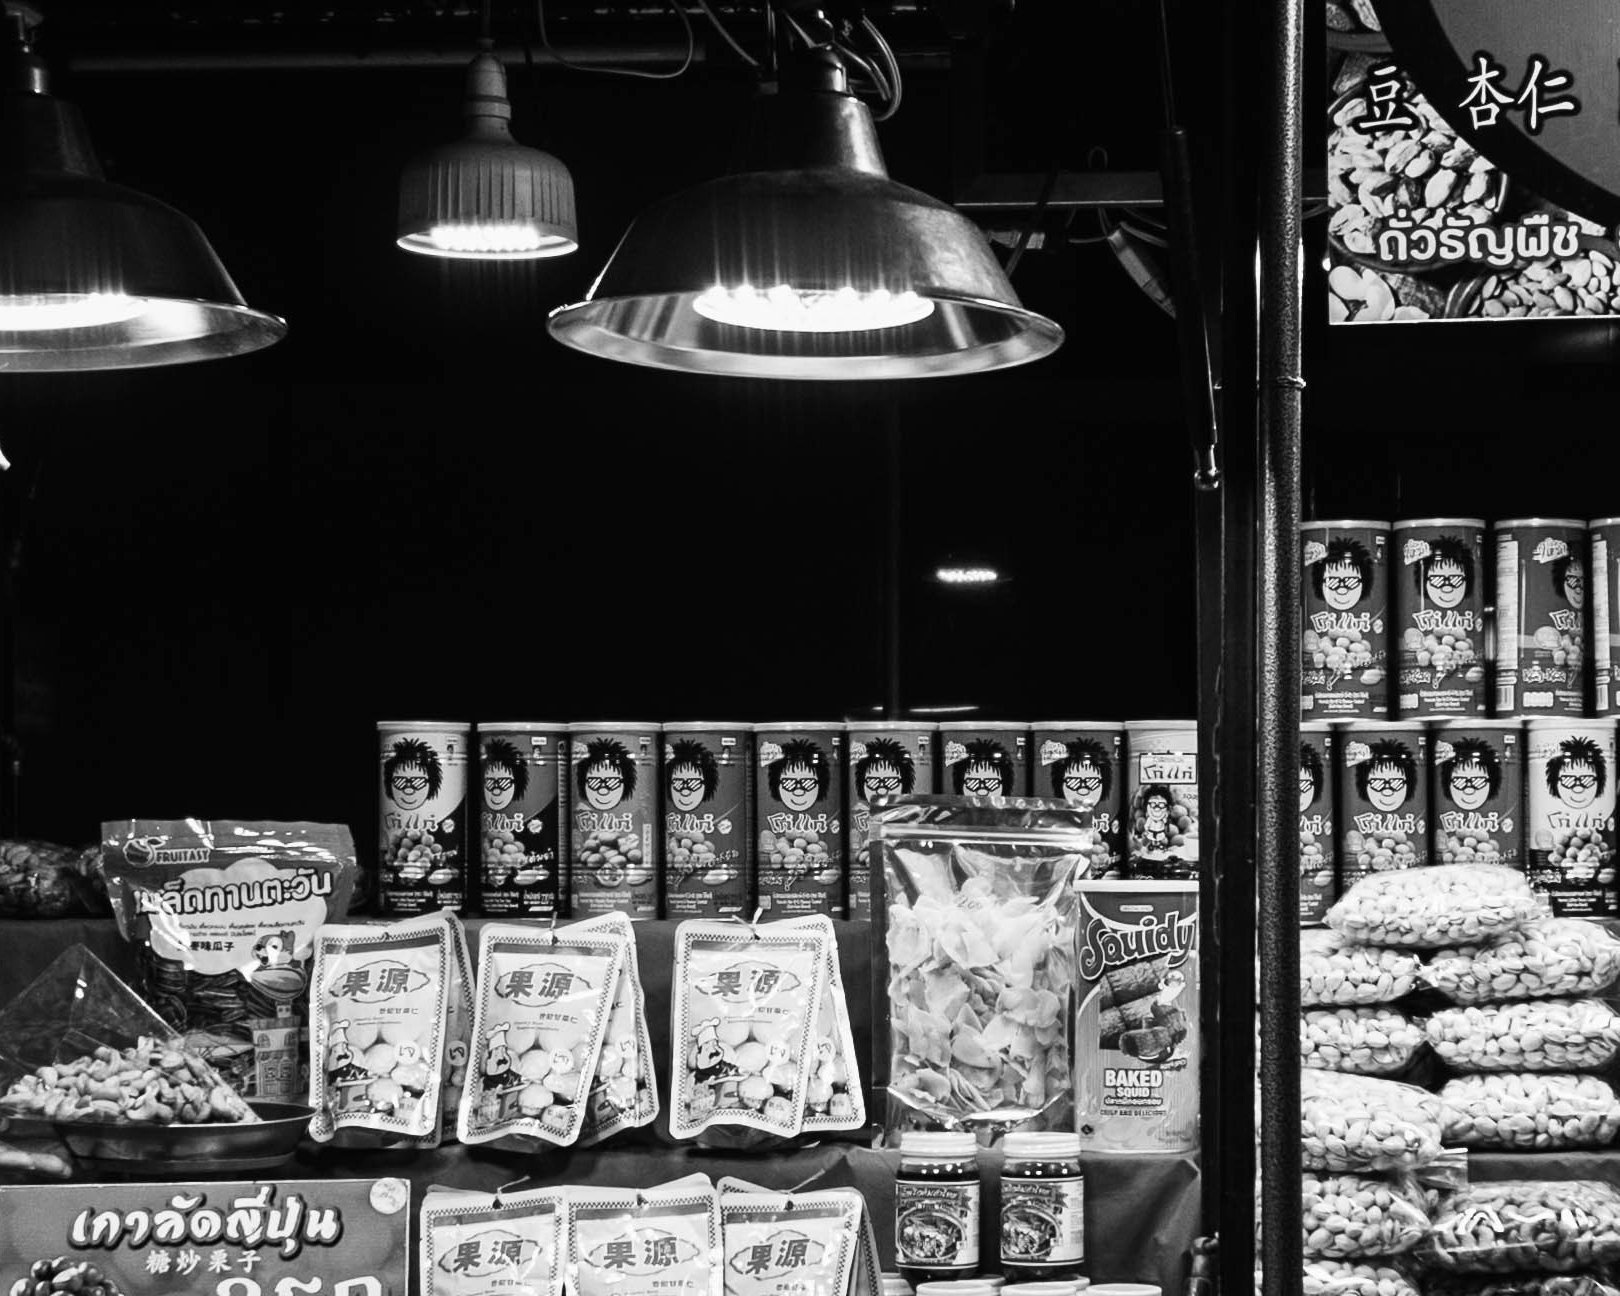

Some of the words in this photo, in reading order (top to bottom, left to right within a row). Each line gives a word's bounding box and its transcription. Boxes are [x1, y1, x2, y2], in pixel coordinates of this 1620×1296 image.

[1359, 65, 1414, 133] 豆
[1458, 56, 1576, 131] 杏仁
[1378, 208, 1580, 265] ถั่วธัญพืช
[156, 848, 210, 864] FRUITASY
[1079, 910, 1196, 981] Squidy
[341, 967, 411, 998] 果源
[504, 970, 575, 1000] 果源
[1104, 1069, 1163, 1088] BAKED
[1116, 1087, 1151, 1099] SQUID
[71, 1184, 342, 1258] เกาลัดญี่ปุ่น
[144, 1249, 263, 1276] 糖炒栗子
[452, 1239, 524, 1272] 果源
[603, 1236, 679, 1270] 果源
[745, 1239, 811, 1275] 果源
